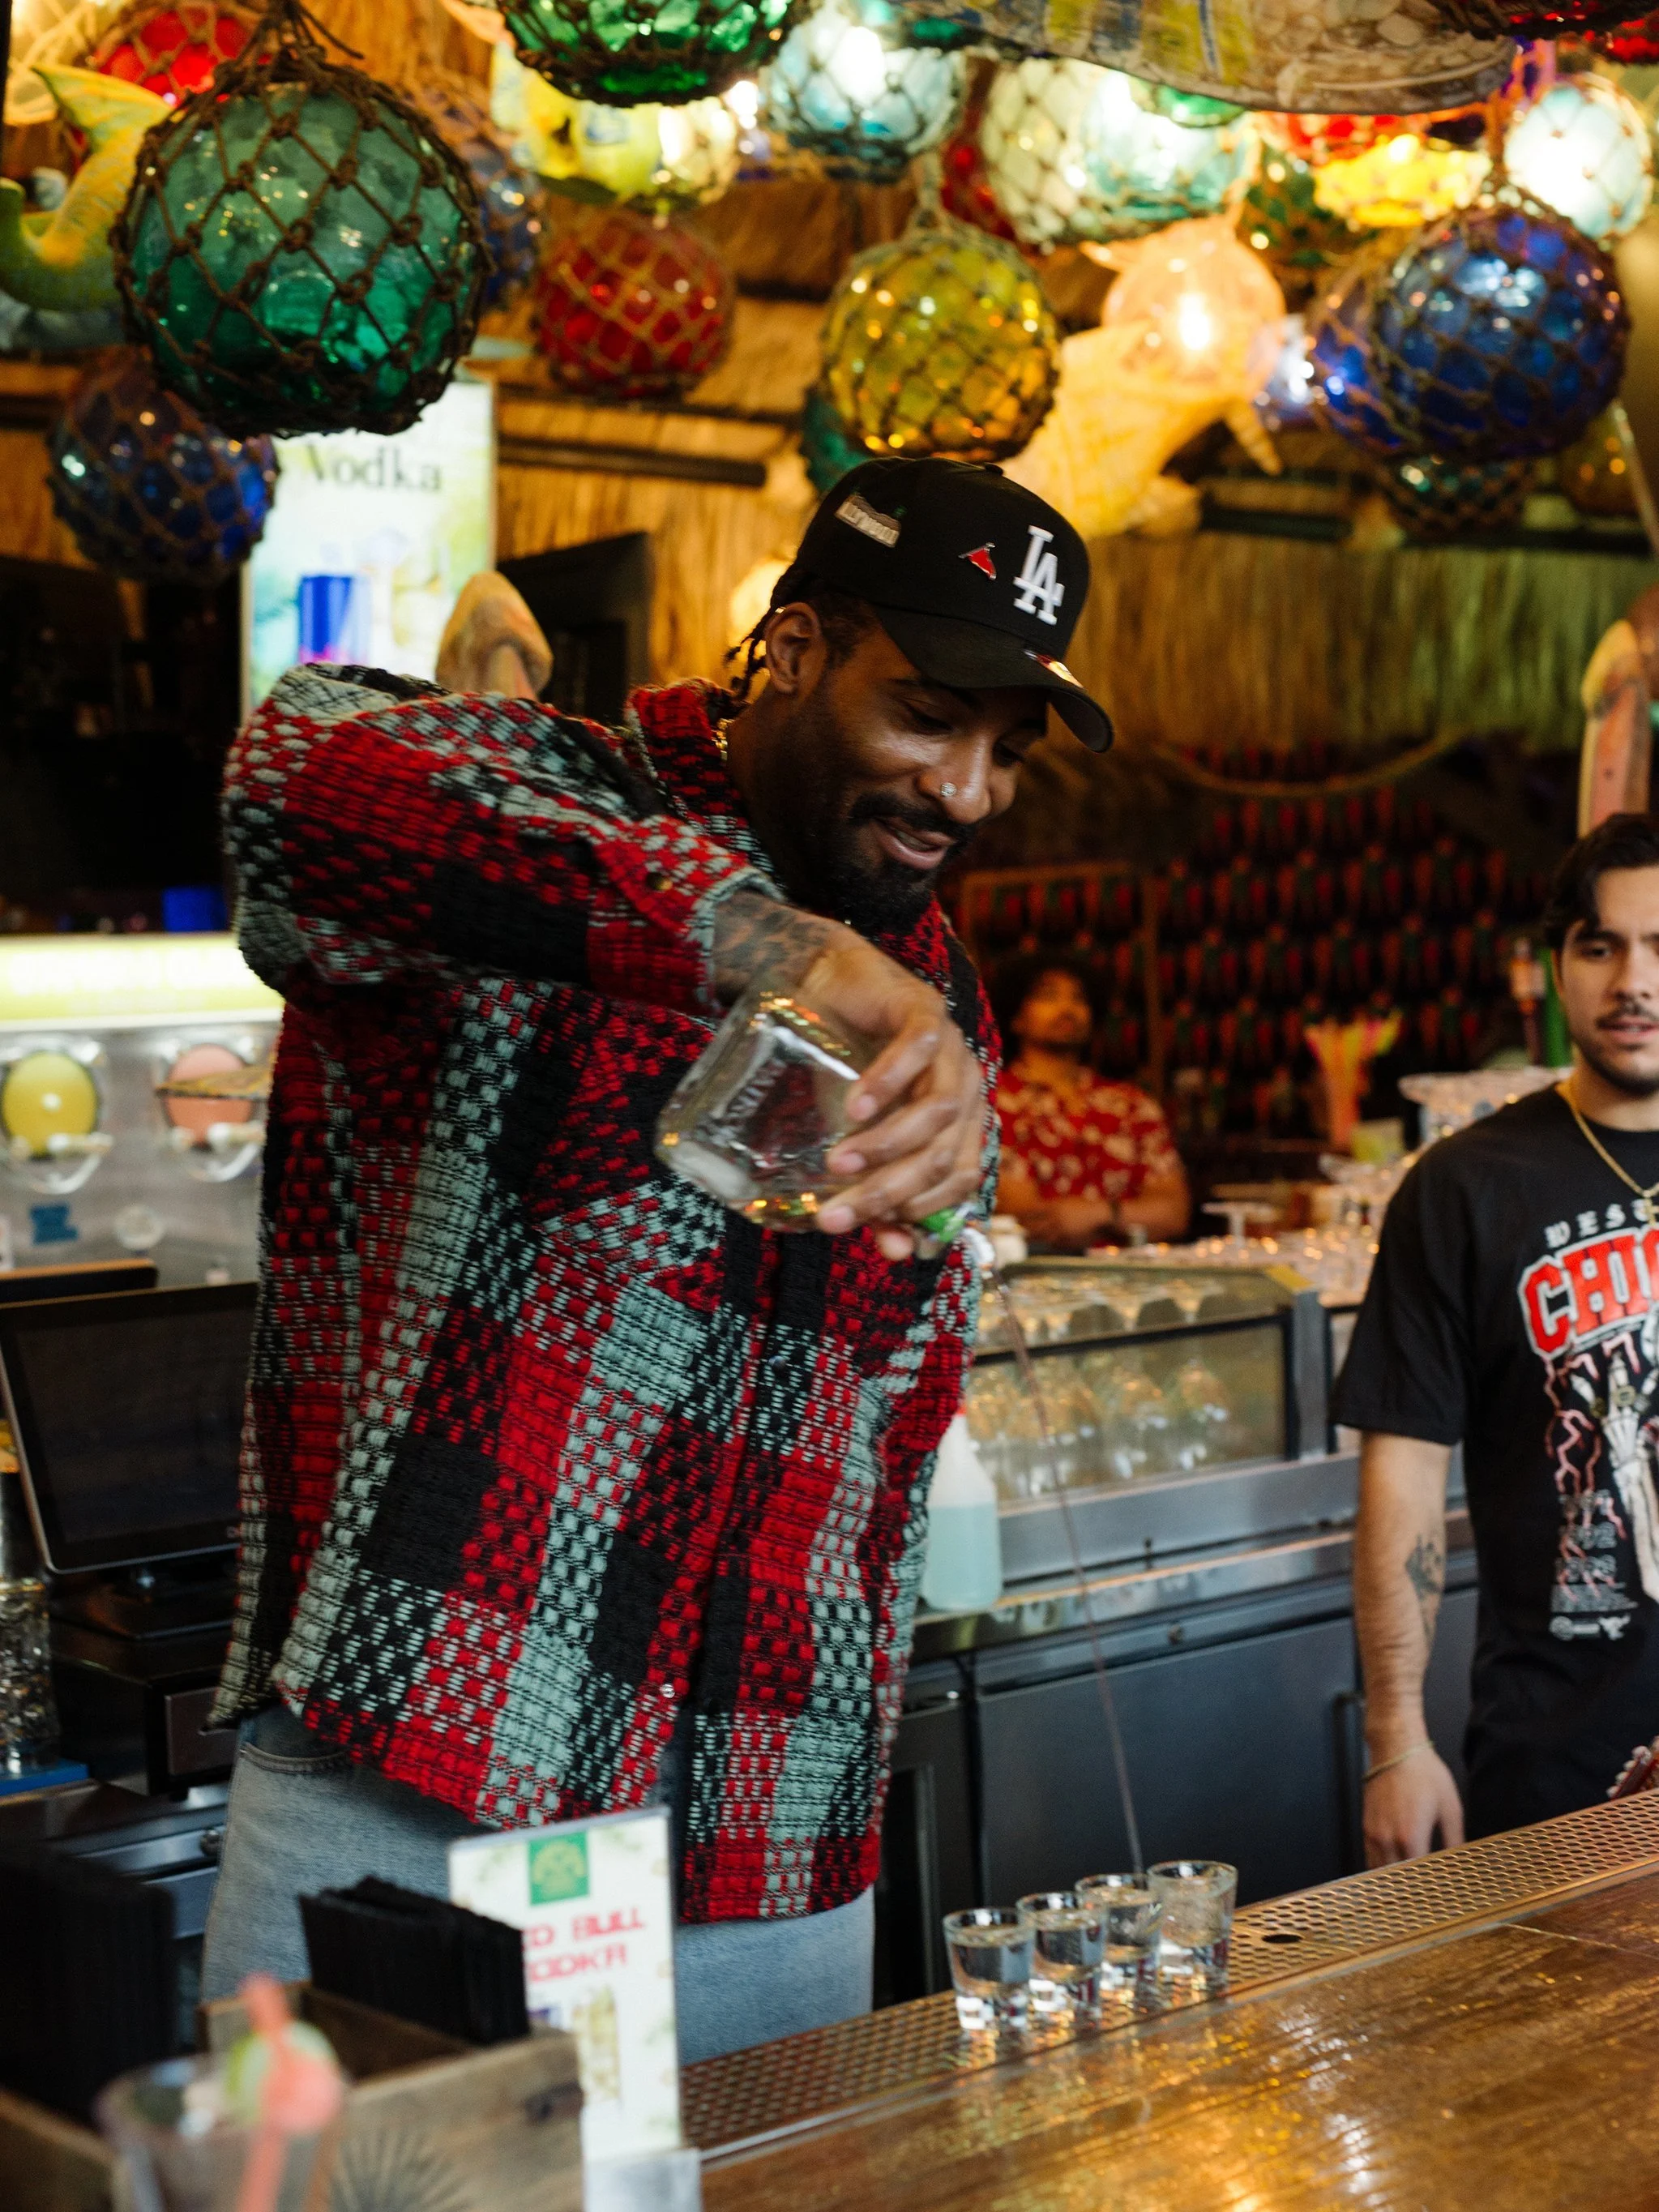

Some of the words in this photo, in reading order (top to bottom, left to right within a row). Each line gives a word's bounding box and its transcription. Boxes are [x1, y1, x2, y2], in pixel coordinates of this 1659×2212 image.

[305, 443, 443, 492] Vodka
[1013, 524, 1065, 625] LA
[523, 1941, 627, 1983] ODKA
